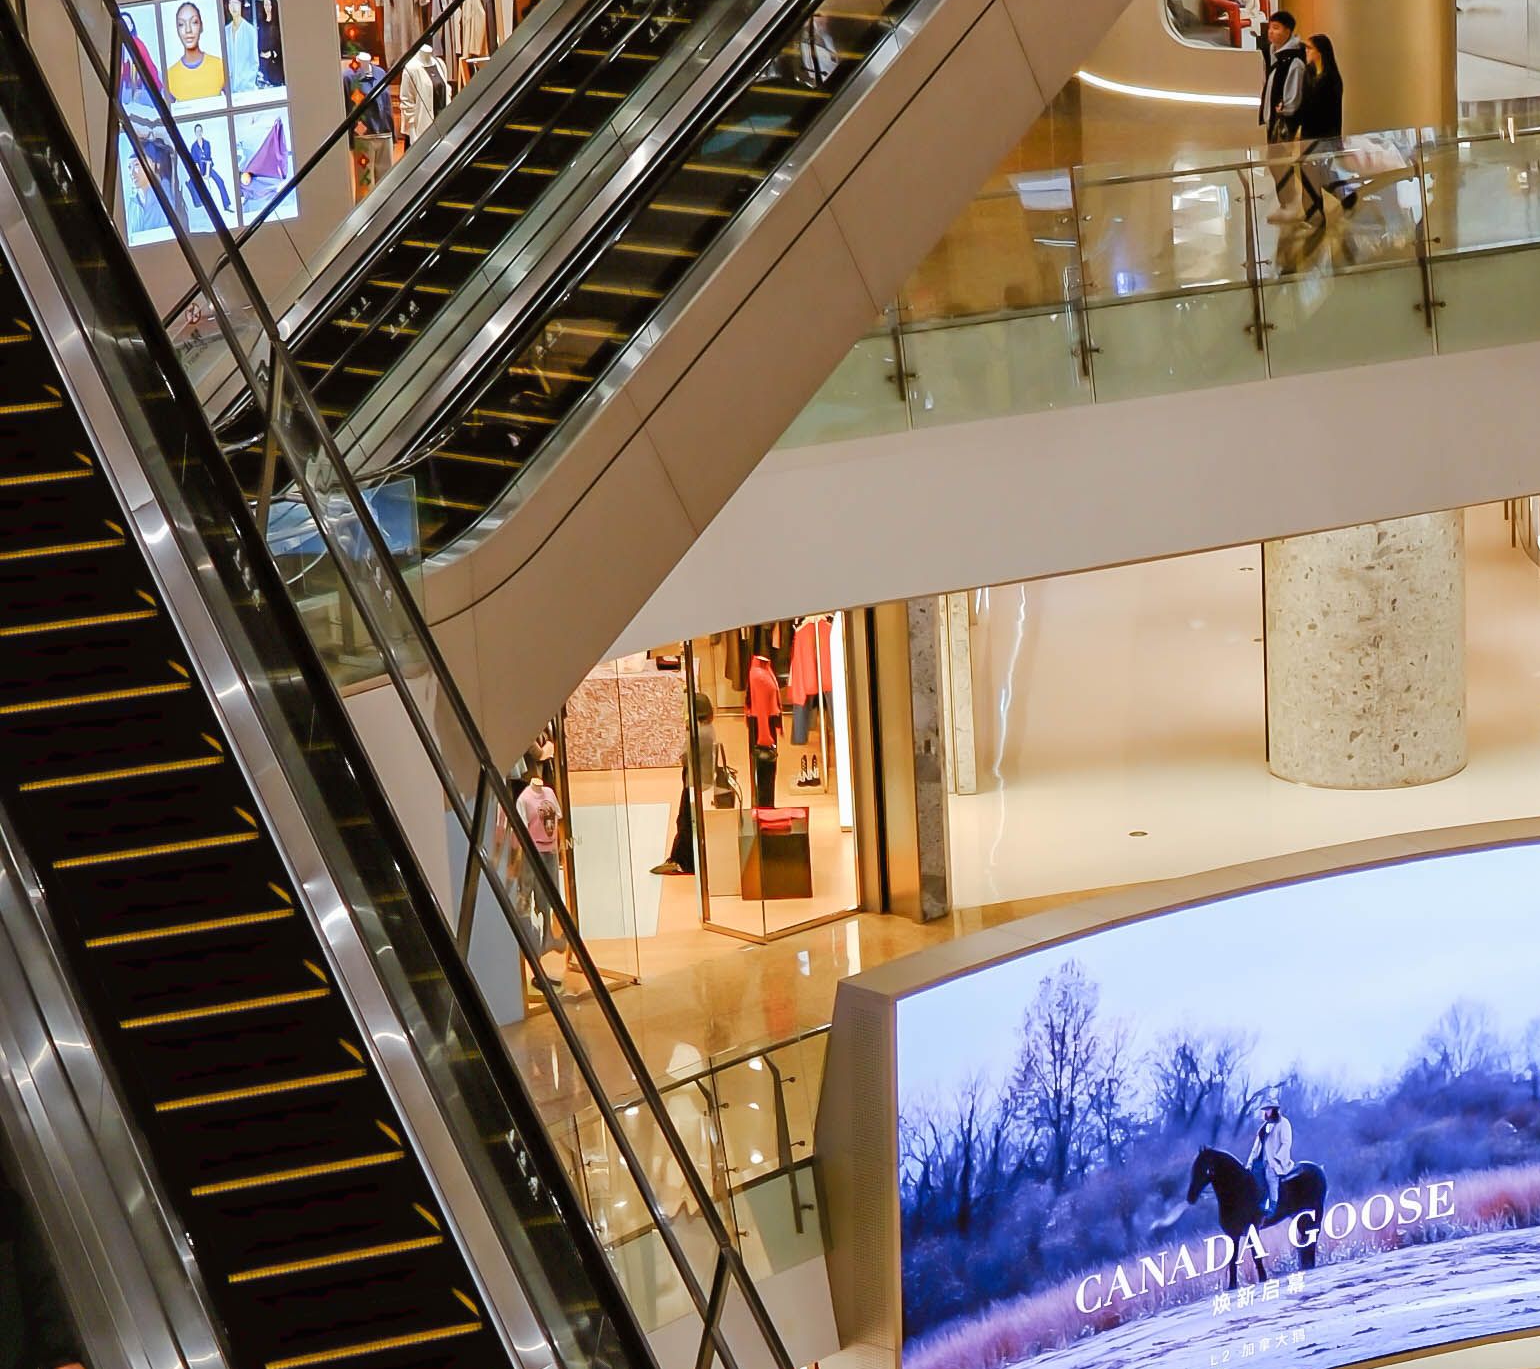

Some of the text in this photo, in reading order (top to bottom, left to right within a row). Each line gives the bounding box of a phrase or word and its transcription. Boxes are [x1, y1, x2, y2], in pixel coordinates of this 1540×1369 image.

[1075, 1180, 1455, 1314] CANADA GOOSE
[1212, 1271, 1306, 1318] 焕新启幕
